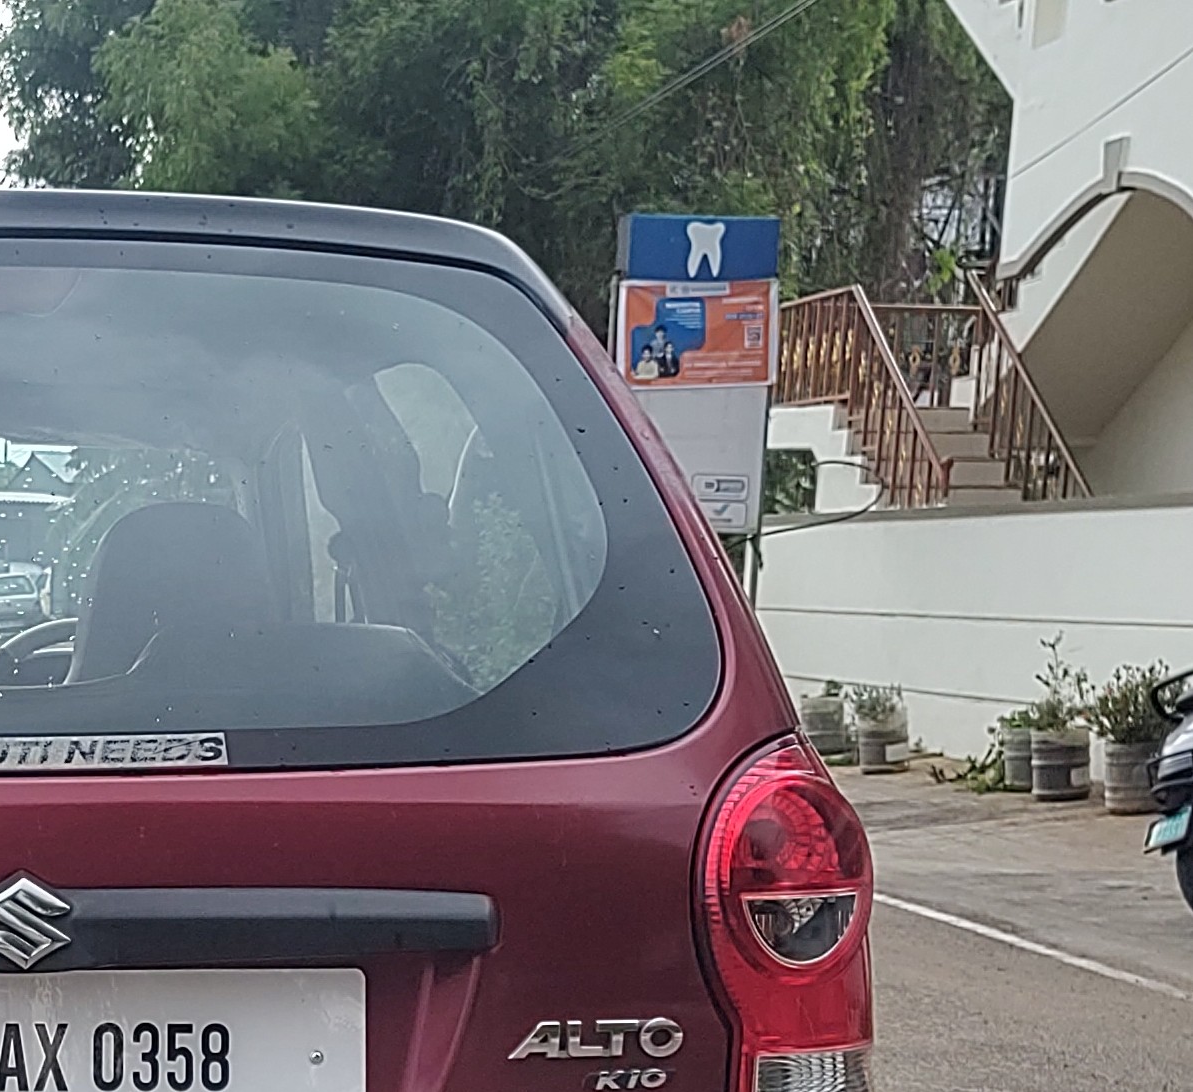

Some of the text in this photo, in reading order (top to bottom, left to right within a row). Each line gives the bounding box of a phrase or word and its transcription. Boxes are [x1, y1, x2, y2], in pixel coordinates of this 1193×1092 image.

[64, 736, 224, 764] NEEDS
[507, 1017, 684, 1060] ALTO
[92, 1022, 231, 1092] 0358
[595, 1068, 667, 1091] K10
